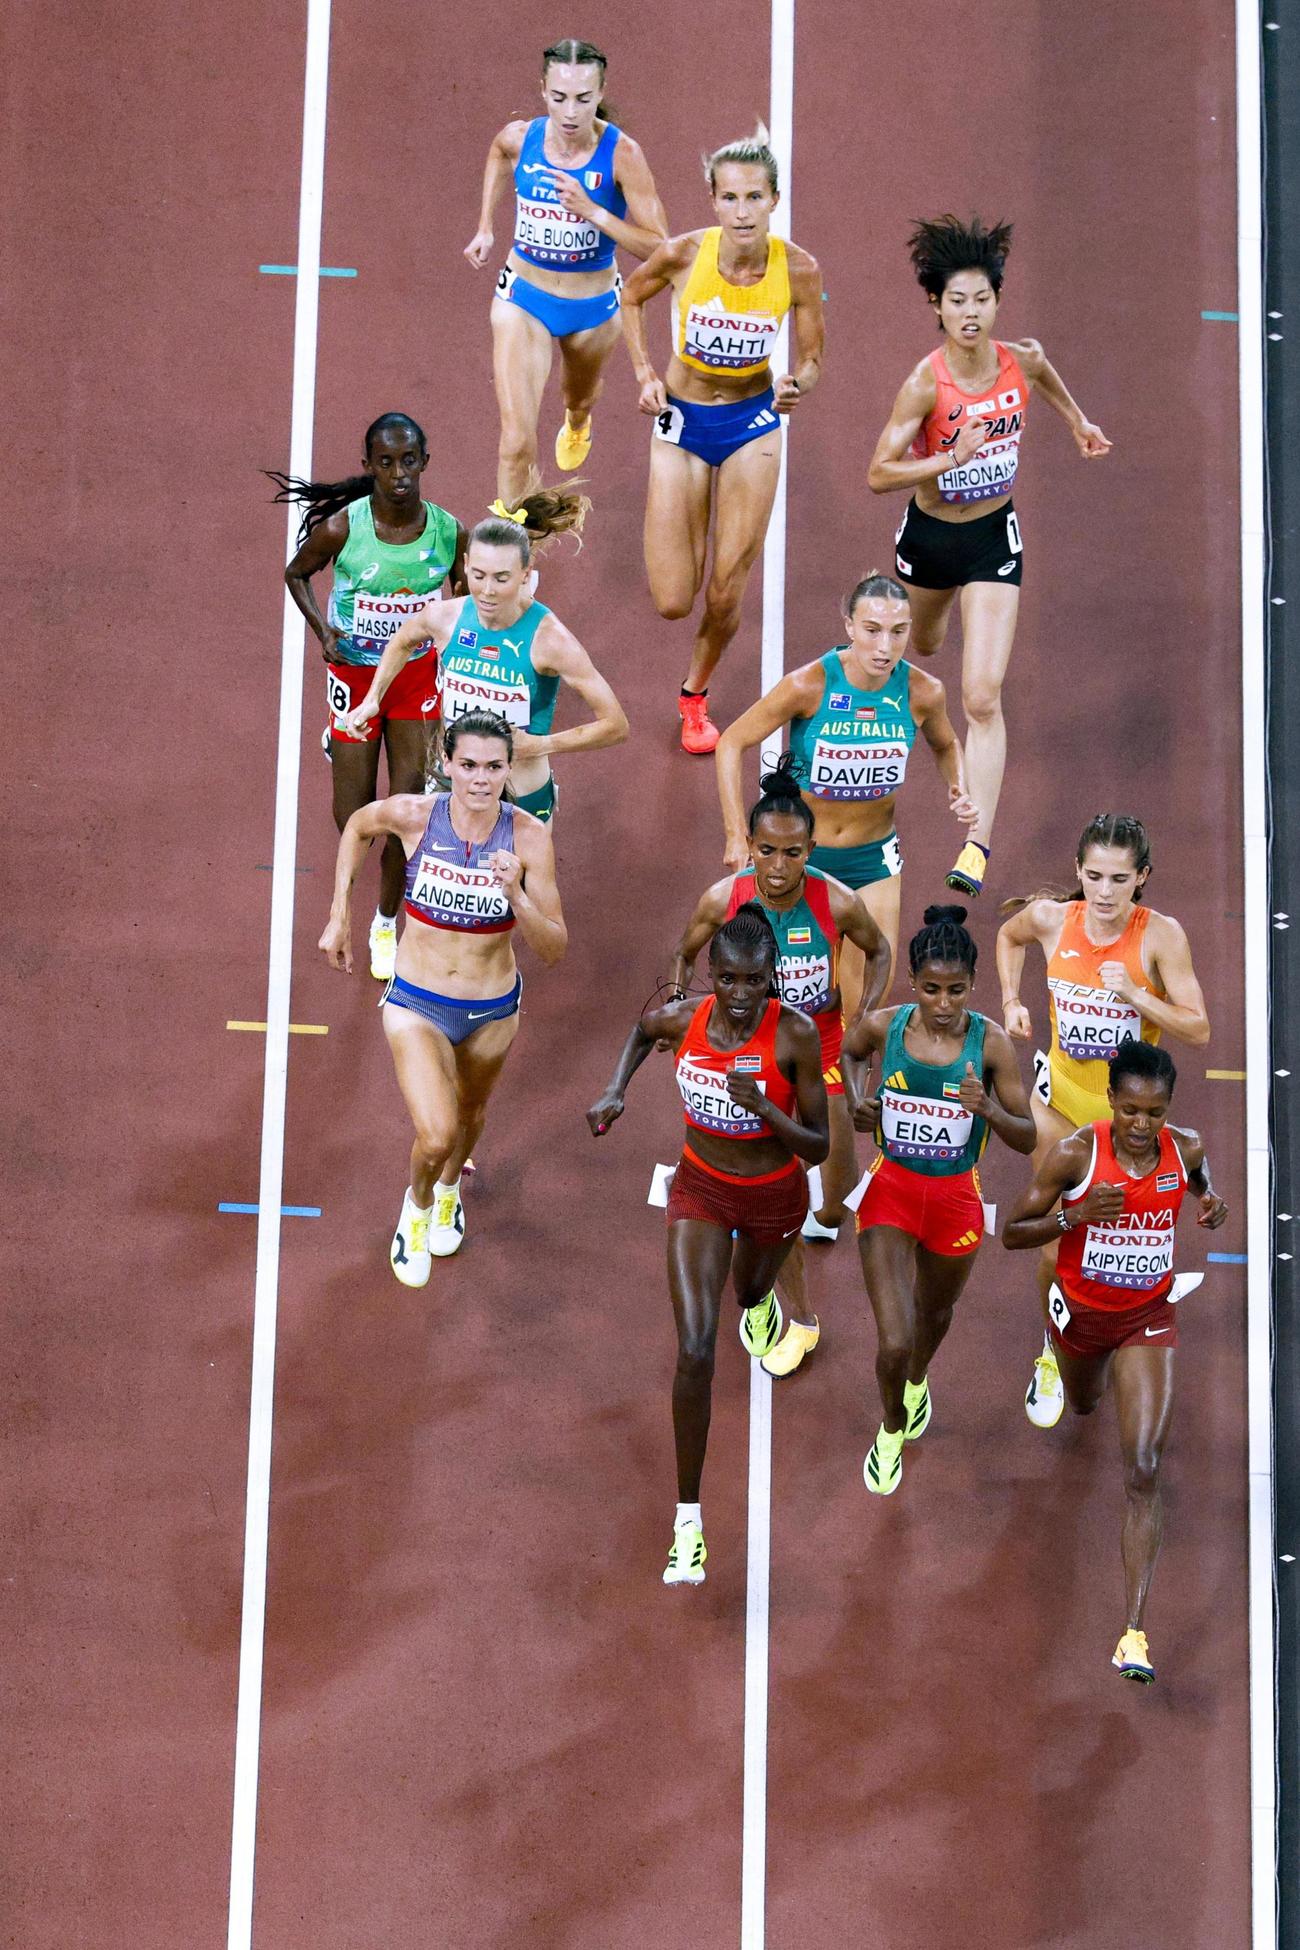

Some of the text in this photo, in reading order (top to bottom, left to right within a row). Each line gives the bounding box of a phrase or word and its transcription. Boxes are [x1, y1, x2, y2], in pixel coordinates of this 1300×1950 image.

[532, 186, 558, 201] ITA
[519, 220, 596, 248] DEL BUONO
[690, 311, 776, 334] HONDA
[695, 331, 765, 355] LAHTI
[658, 410, 673, 435] 4
[941, 411, 1024, 446] JPAN
[974, 440, 1020, 460] NDA
[1009, 519, 1019, 547] 1
[358, 598, 435, 614] HOND
[357, 617, 402, 638] HASSA
[447, 656, 526, 687] AUSTRALIA
[329, 676, 347, 712] 18
[446, 677, 528, 703] HONDA
[820, 721, 907, 739] AUSTRALIA
[817, 746, 904, 760] HONDA
[817, 765, 899, 785] DAVIES
[421, 861, 504, 889] HONDA
[416, 883, 503, 916] ANDREWS
[1056, 997, 1139, 1020] HONDA
[1060, 1020, 1135, 1045] GARCÍA
[679, 1066, 727, 1091] HON
[884, 1095, 971, 1121] HONDA
[895, 1120, 952, 1145] EISA
[1089, 1231, 1172, 1247] HONDA
[1087, 1250, 1170, 1273] KIPYEGON
